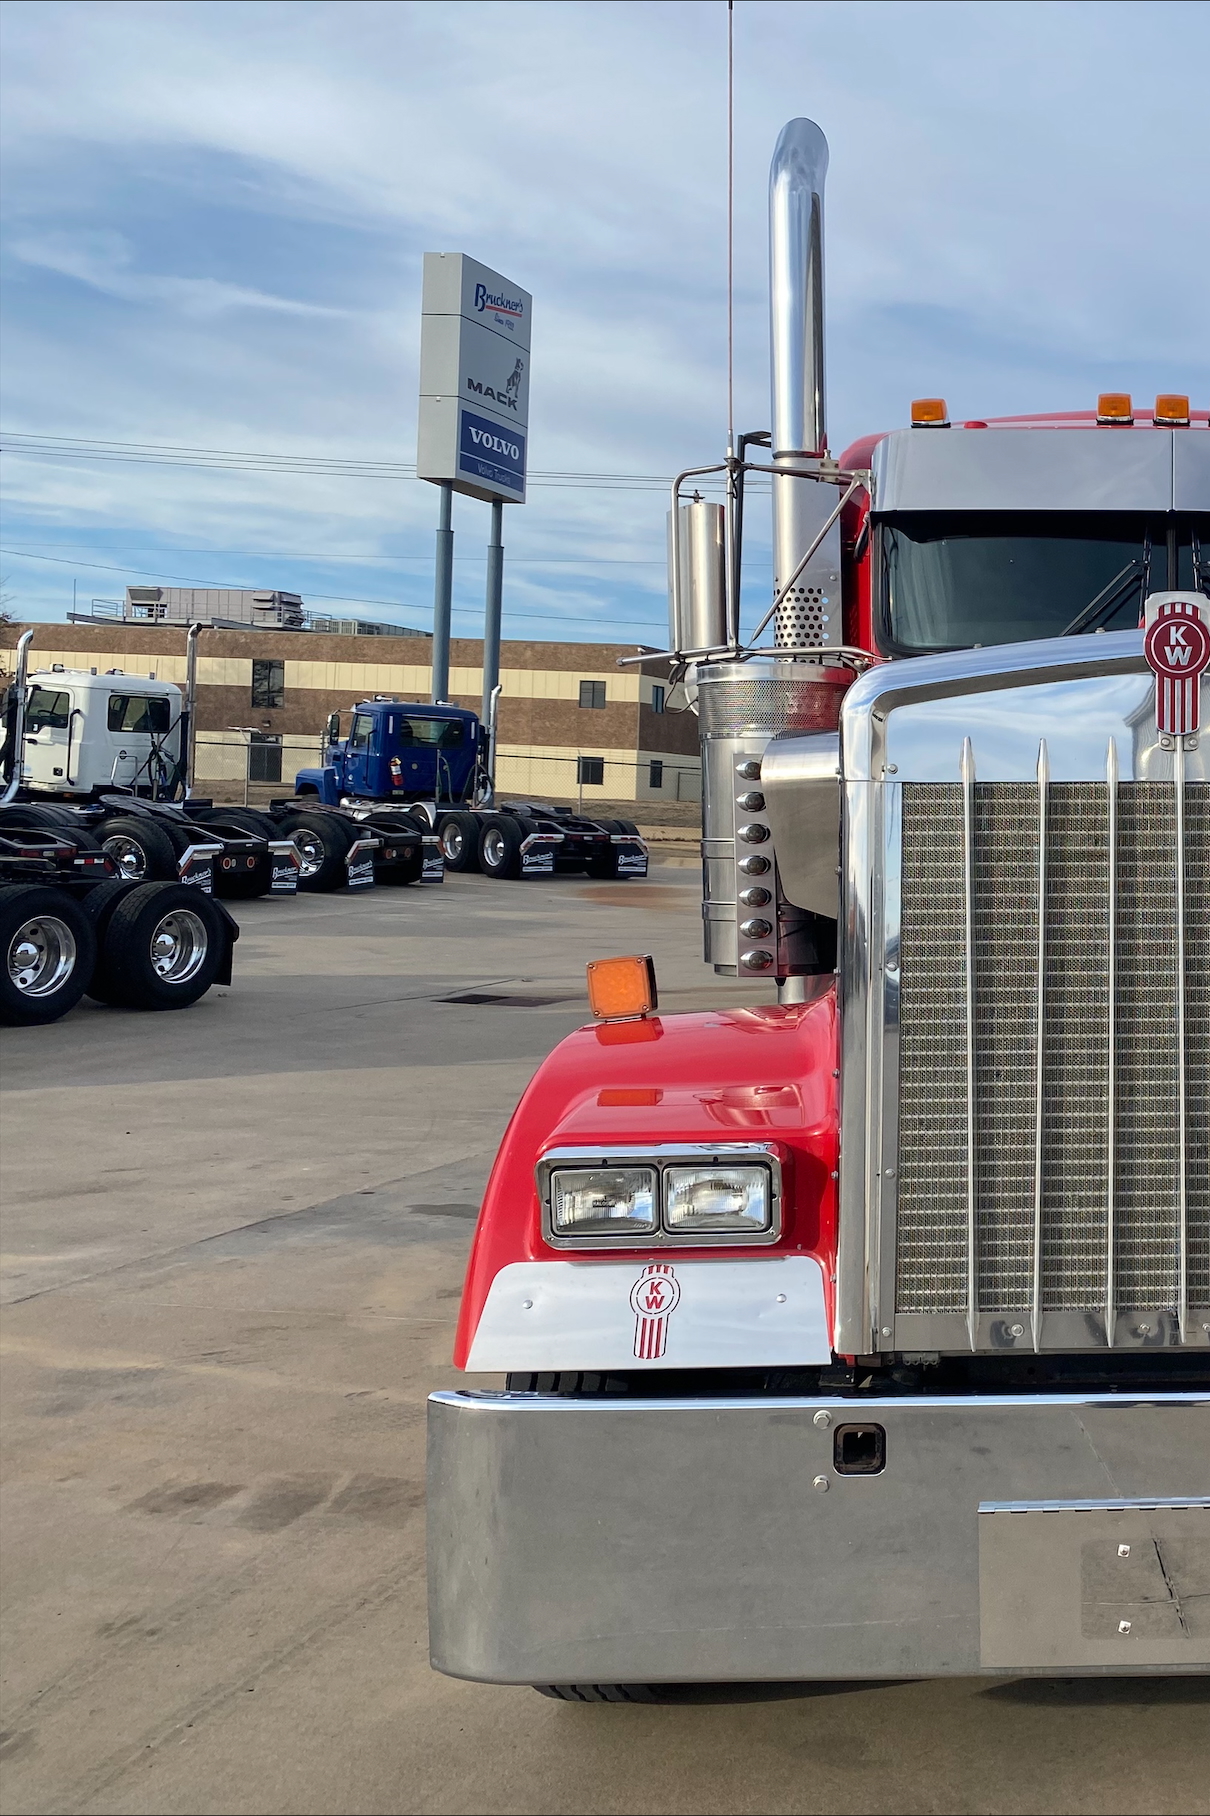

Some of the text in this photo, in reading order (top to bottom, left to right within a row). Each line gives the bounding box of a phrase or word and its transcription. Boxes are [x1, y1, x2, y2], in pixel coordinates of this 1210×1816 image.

[474, 283, 524, 313] Bruckner's
[467, 377, 518, 411] MACK
[469, 426, 520, 460] VOLVO
[1170, 626, 1188, 645] K
[1164, 646, 1193, 666] W
